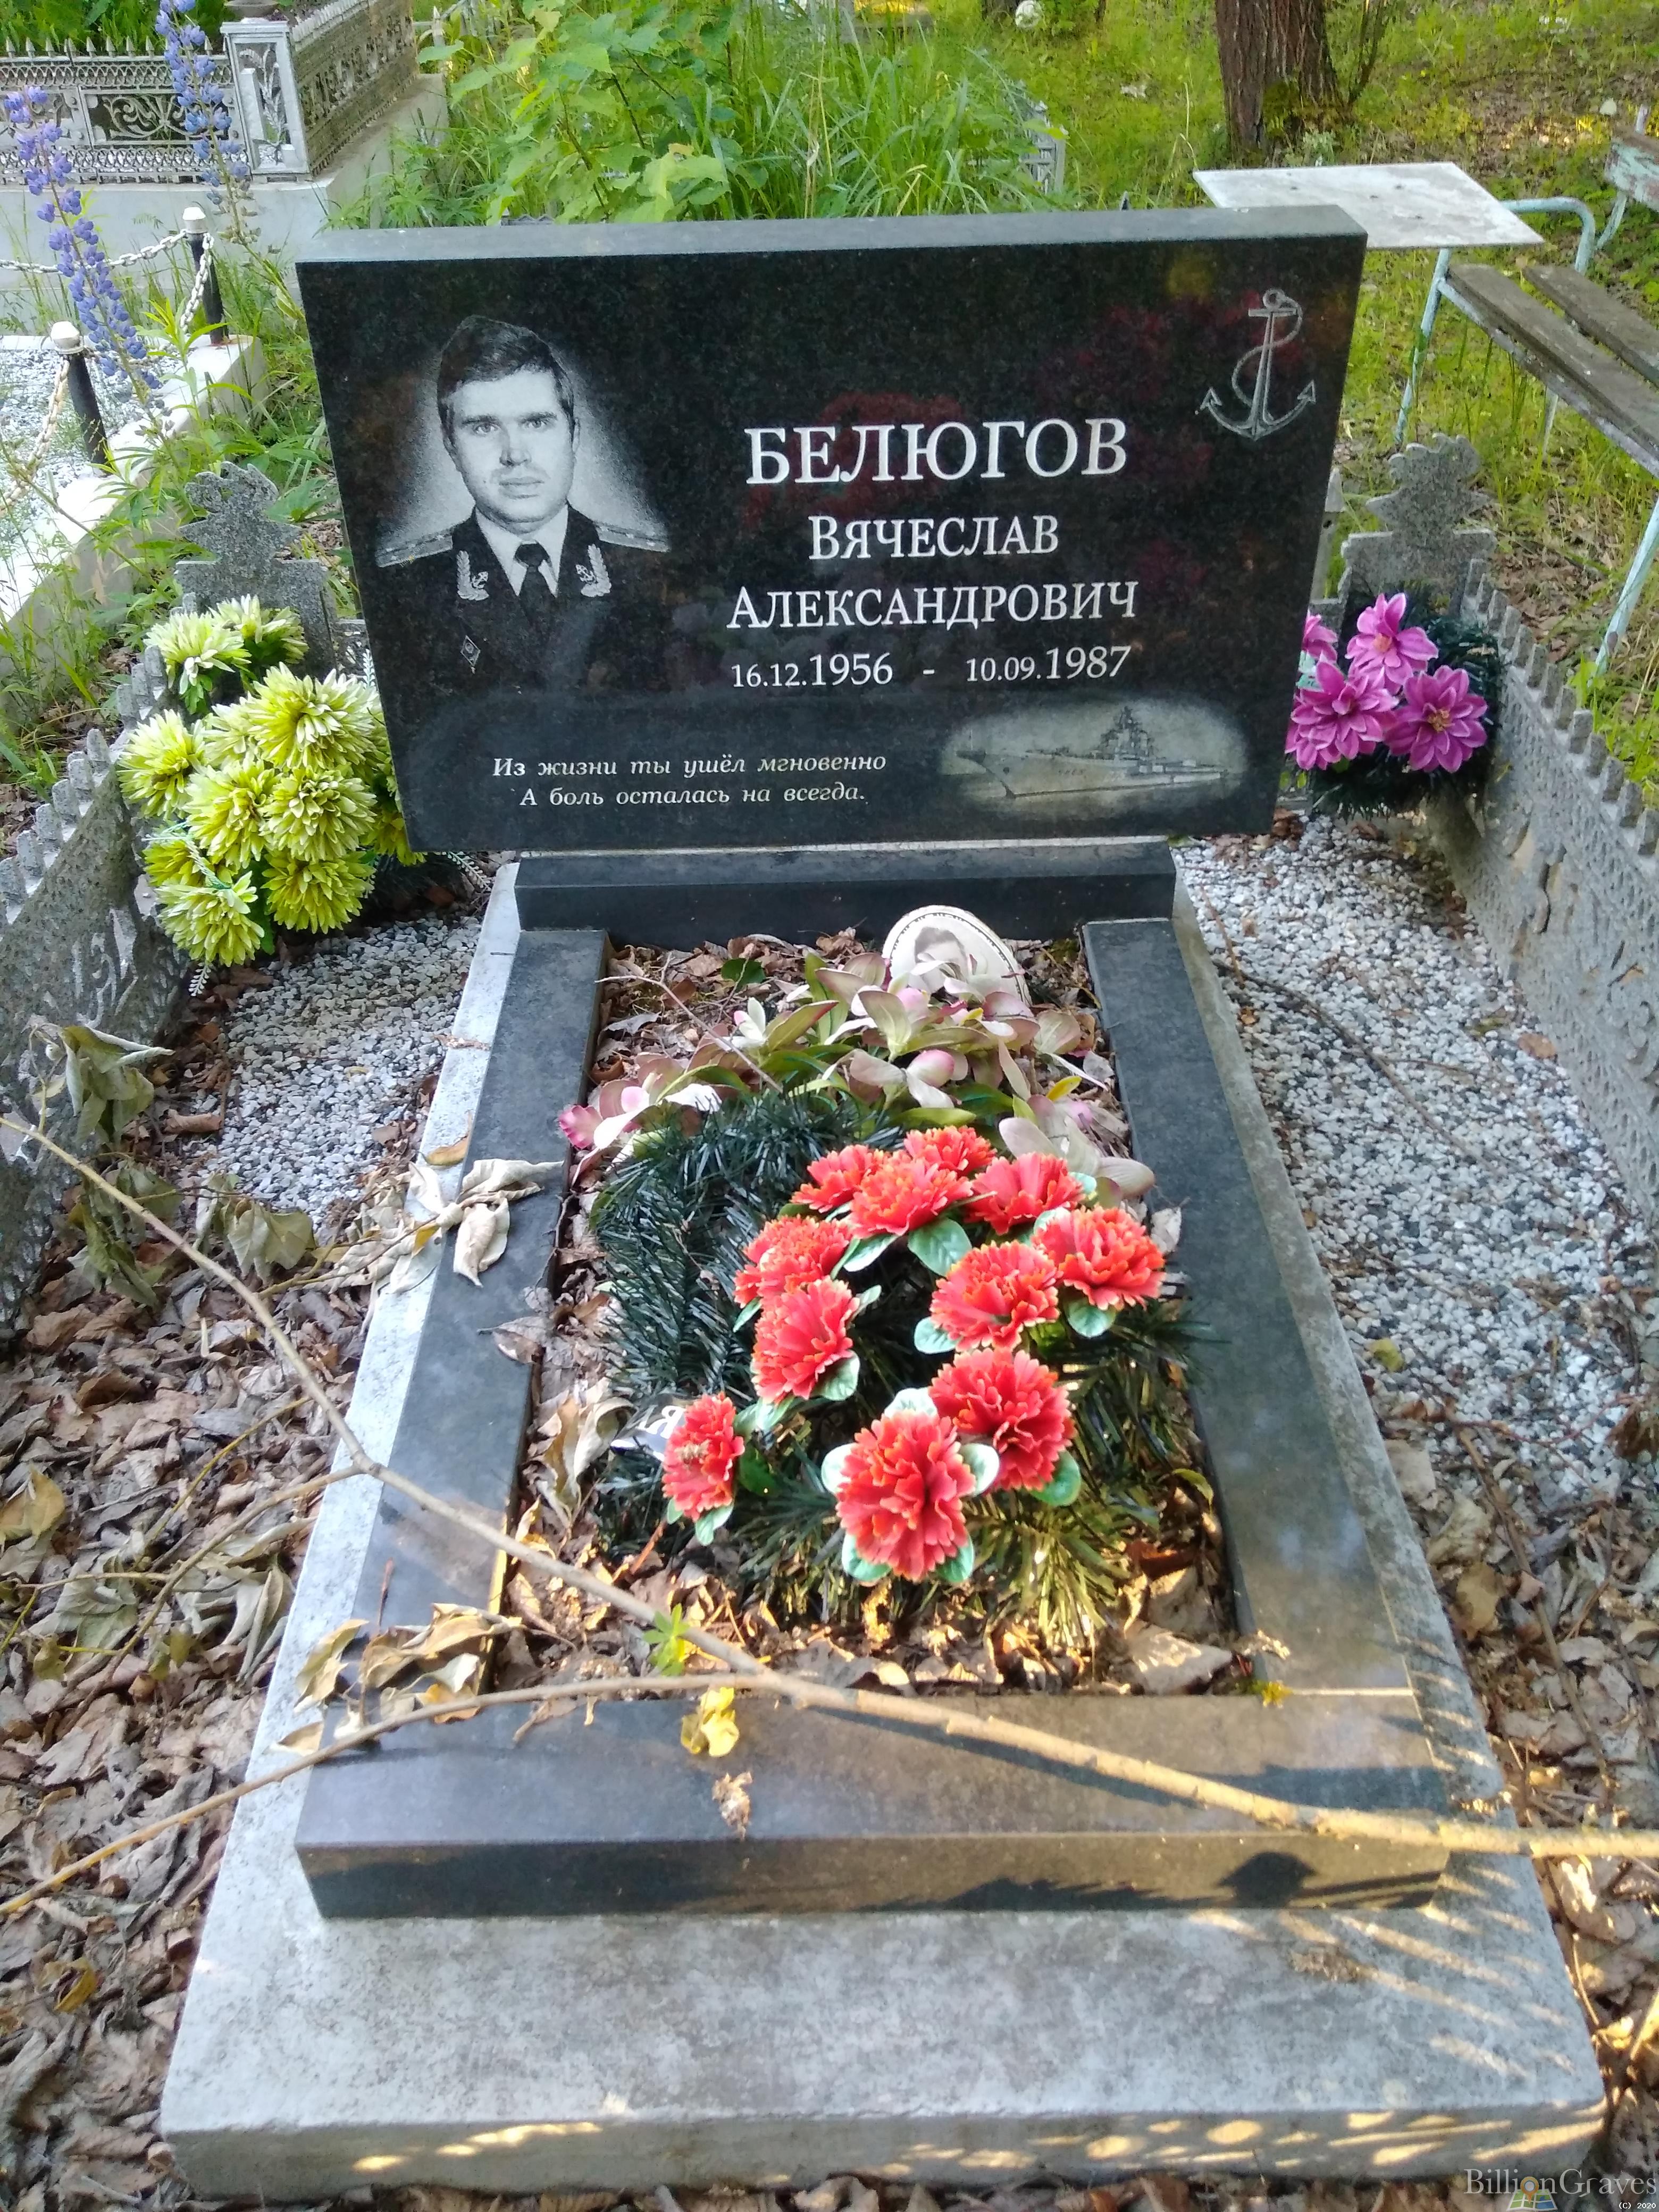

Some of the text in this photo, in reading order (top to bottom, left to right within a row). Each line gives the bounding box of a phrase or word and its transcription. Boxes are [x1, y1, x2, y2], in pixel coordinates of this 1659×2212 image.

[744, 418, 1127, 484] БЕЛЮГОВ
[808, 515, 1059, 560] ВЯЧЕСЛАВ
[726, 581, 1139, 631] АЛЕКСАНДРОВИЧ
[731, 652, 893, 688] 16.12.1956
[966, 645, 1132, 682] 10.09.1987
[492, 753, 886, 778] Из жизни ты ушёл мгновенно
[519, 781, 865, 806] А боль осталась на всегда.
